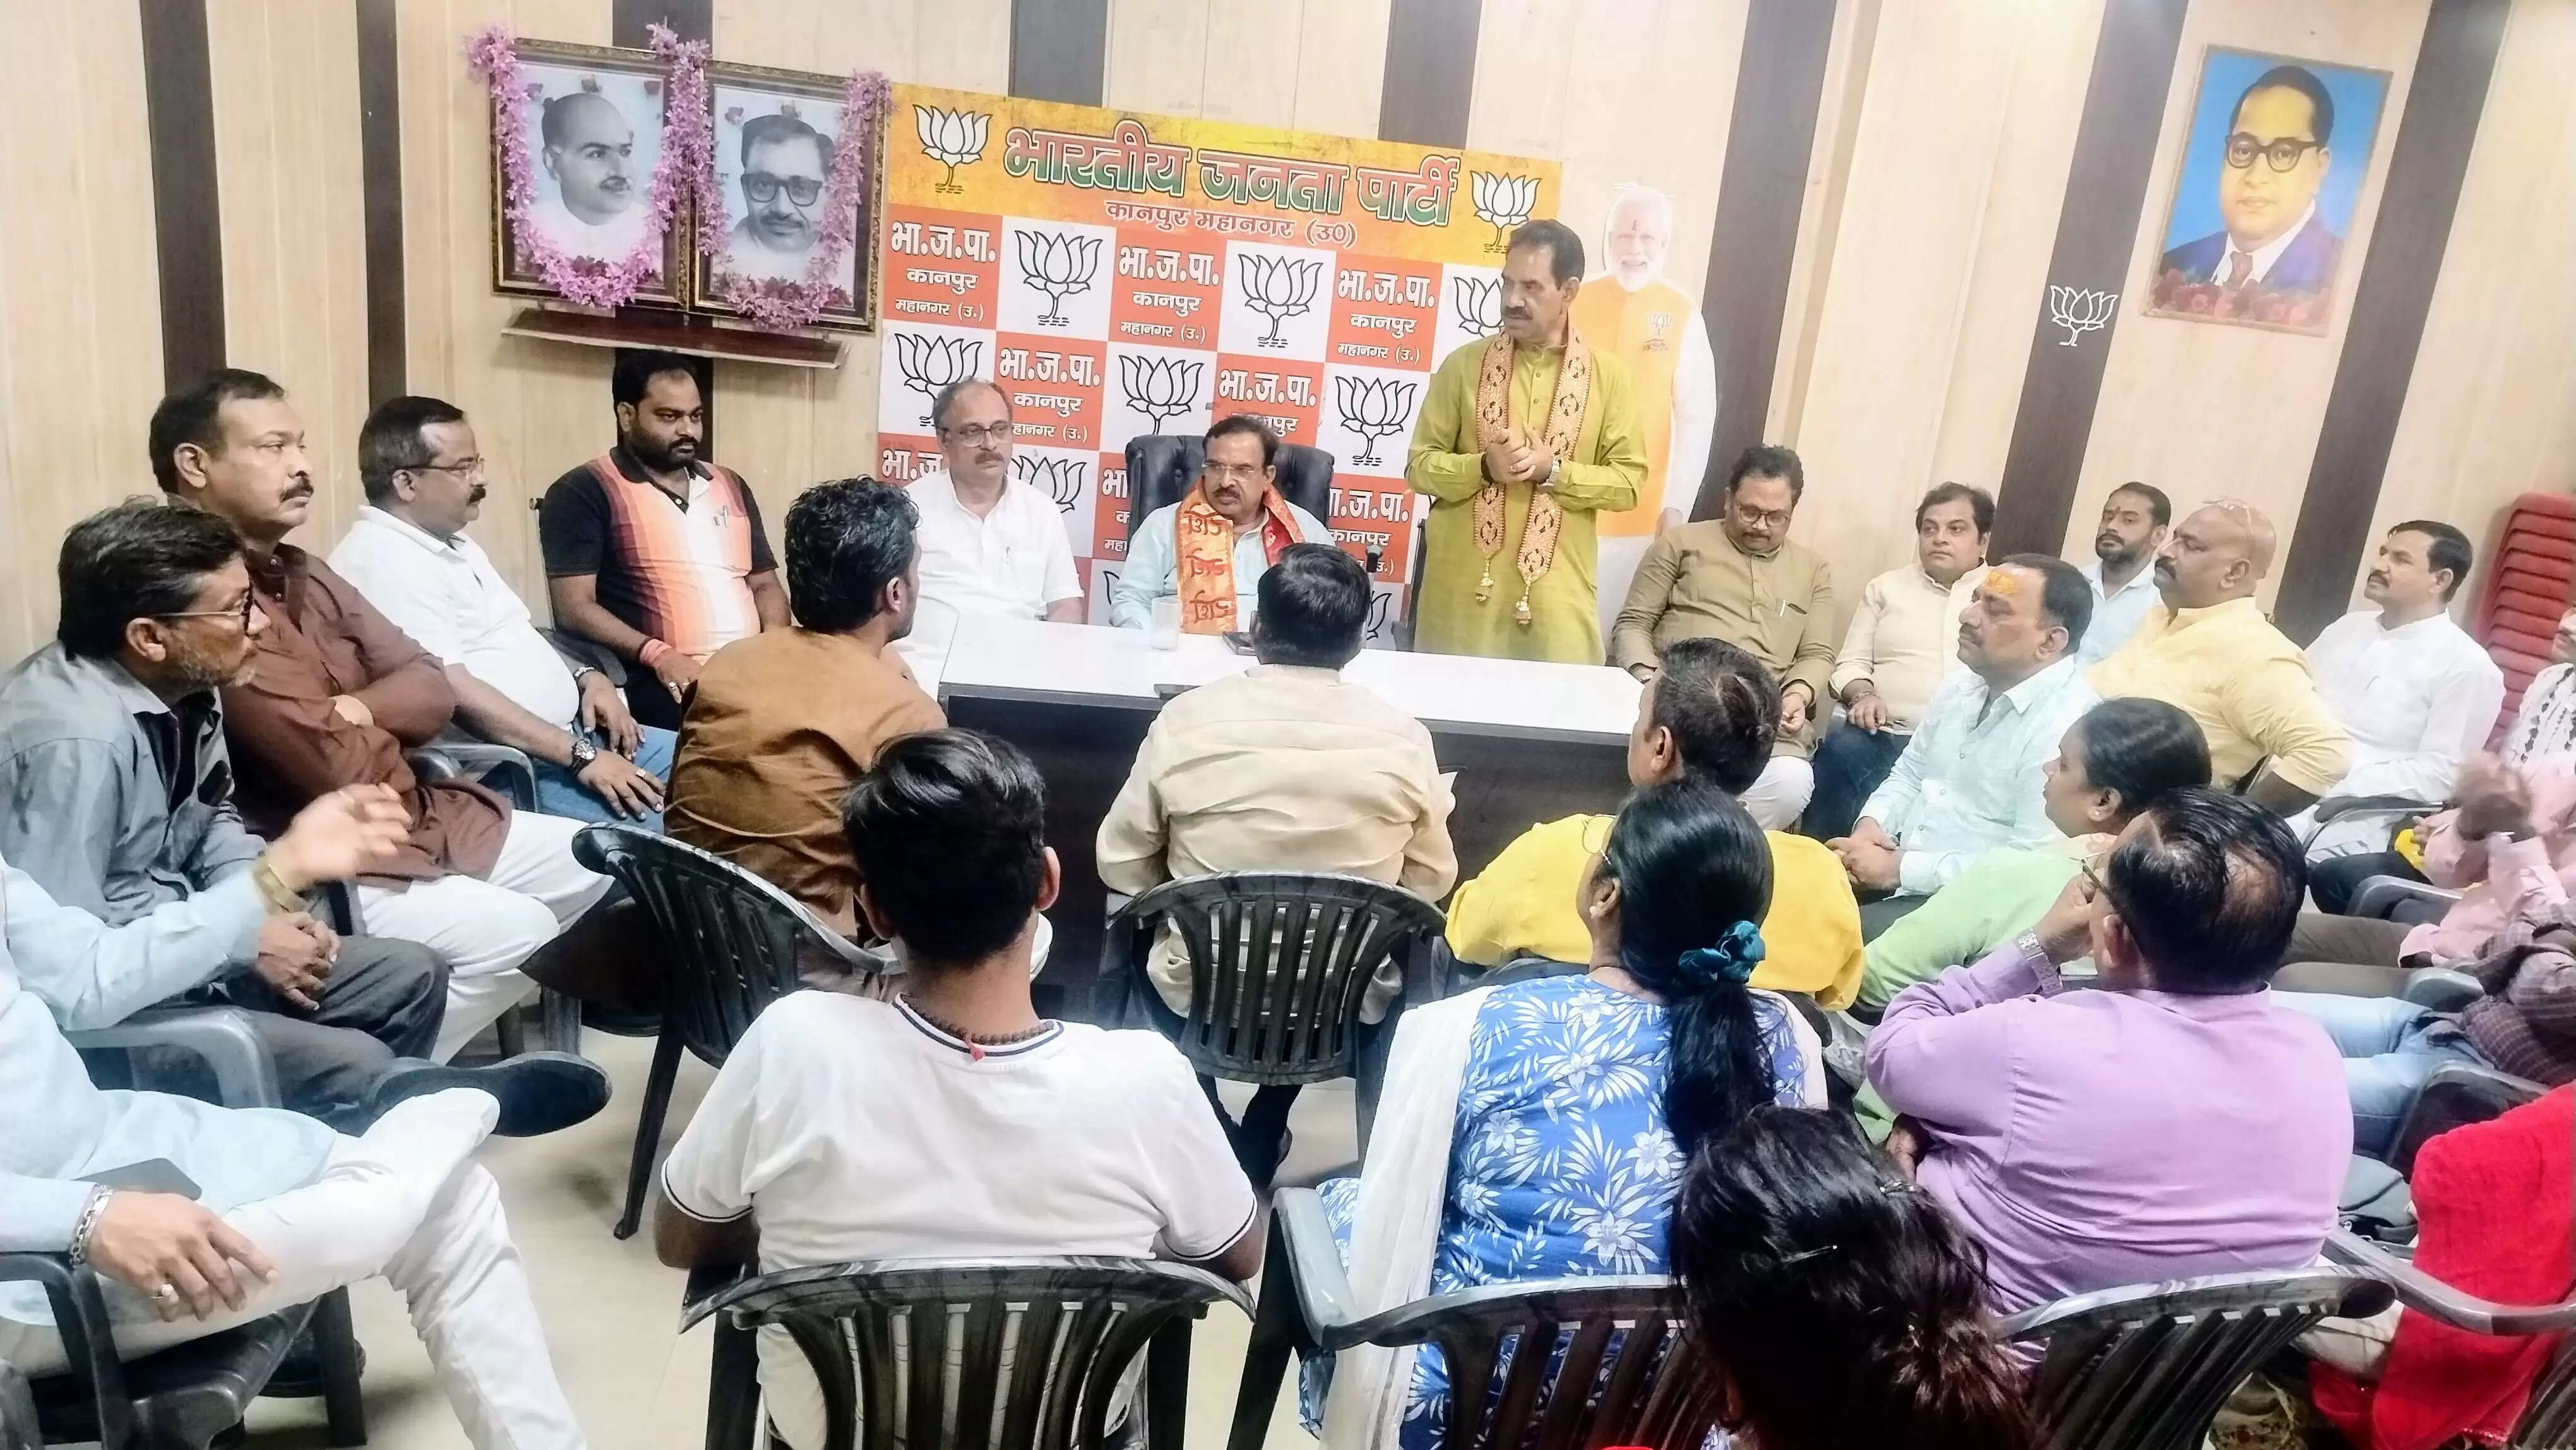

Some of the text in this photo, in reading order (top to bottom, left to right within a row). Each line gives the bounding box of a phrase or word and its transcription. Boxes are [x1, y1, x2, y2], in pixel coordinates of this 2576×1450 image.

[1003, 119, 1461, 227] भारतीय जनता पार्टी
[1105, 200, 1191, 231] कानपुर
[1194, 210, 1296, 239] महानगर
[890, 221, 996, 263] भा.ज.पा.
[1117, 244, 1220, 287] भा.ज.पा.
[906, 267, 979, 296] कानपुर
[1337, 267, 1436, 309] भा.ज.पा.
[894, 298, 951, 316] महानगर
[1132, 290, 1203, 316] कानपुर
[1119, 321, 1174, 339] महानगर
[1349, 312, 1418, 339] कानपुर
[1337, 342, 1389, 359] महानगर
[999, 347, 1101, 387] भा.ज.पा.
[1219, 369, 1317, 407] भा.ज.पा.
[1013, 392, 1084, 418] कानपुर
[1011, 422, 1056, 438] हानगर
